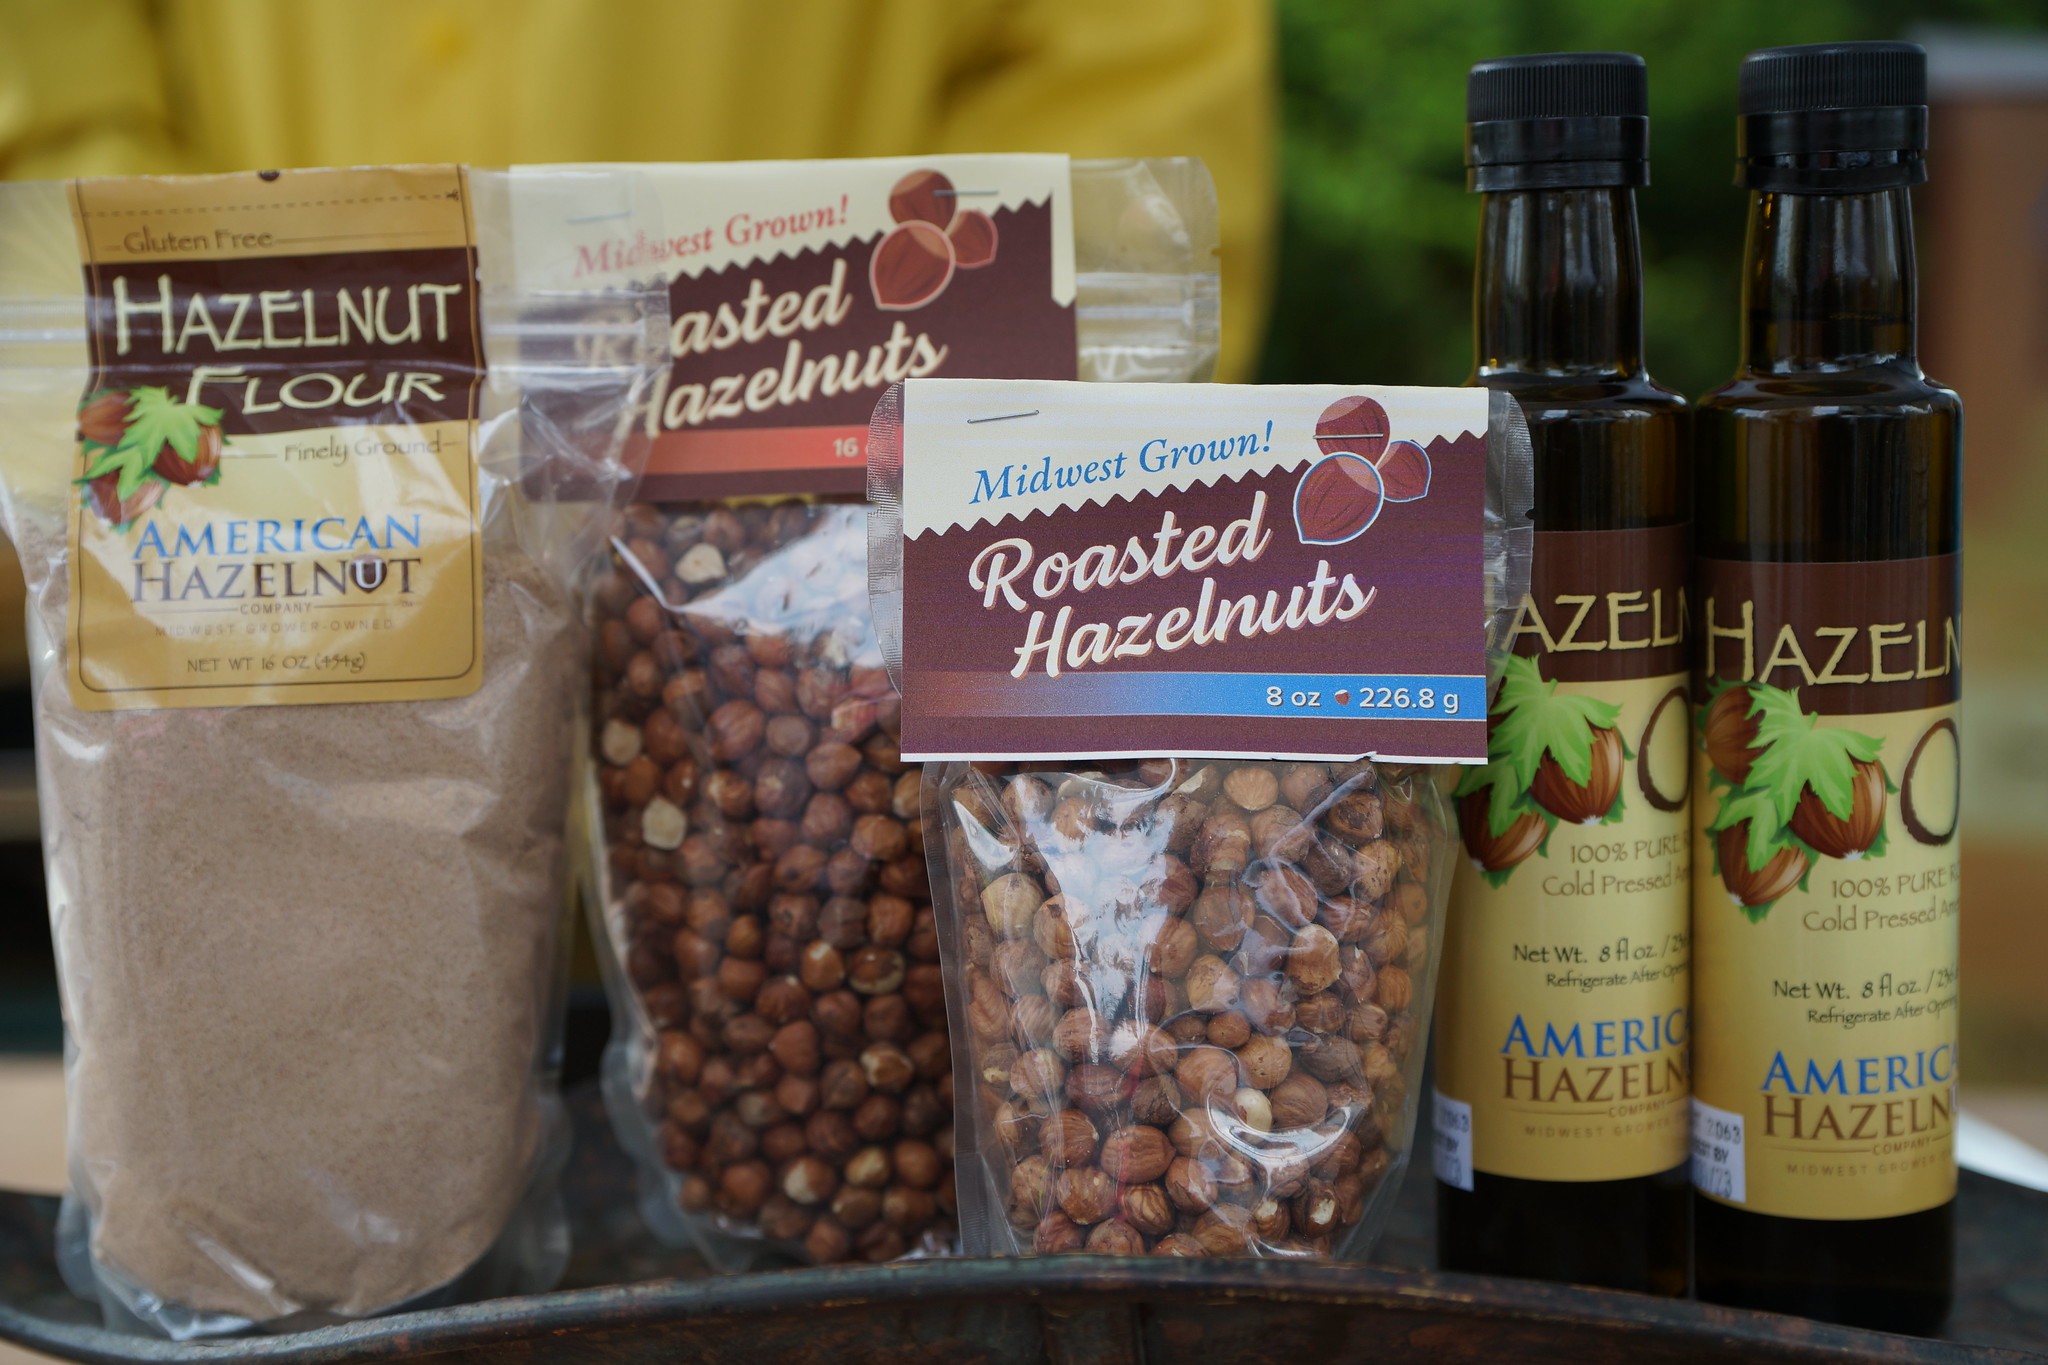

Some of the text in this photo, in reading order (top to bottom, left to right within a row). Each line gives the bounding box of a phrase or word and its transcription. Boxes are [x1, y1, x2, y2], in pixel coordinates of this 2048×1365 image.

[122, 224, 274, 255] Gluten Free
[574, 193, 849, 278] Midwest Grown!
[111, 272, 463, 355] HAZELNUT
[185, 365, 447, 415] FLOUR
[603, 320, 949, 458] Hazelnuts
[283, 430, 442, 467] Finely Ground
[832, 436, 860, 458] 16
[968, 419, 1275, 505] Midwest Grown!
[130, 513, 423, 560] AMERICAN
[968, 490, 1273, 612] Roasted
[131, 554, 422, 603] HAZELNUT
[239, 602, 312, 615] COMPANY
[1009, 558, 1378, 680] Hazelnuts
[154, 623, 235, 637] MIDWEST
[186, 651, 366, 674] NET WT 16 OZ (454g)
[1266, 685, 1460, 715] 8 oz 226.8 g
[1569, 842, 1629, 864] 100%
[1634, 833, 1681, 861] PURE
[1542, 869, 1595, 897] Cold
[1601, 860, 1673, 895] Pressed
[1831, 876, 1892, 899] 100%
[1897, 866, 1948, 895] PURE
[1803, 904, 1857, 932] Cold
[1864, 894, 1937, 931] Pressed
[1513, 944, 1549, 963] Net
[1554, 945, 1588, 964] Wt.
[1598, 946, 1611, 963] 8
[1615, 937, 1629, 962] fl
[1546, 969, 1628, 994] Refrigerate
[1630, 964, 1662, 985] After
[1773, 979, 1811, 999] Net
[1816, 982, 1850, 1000] Wt.
[1861, 981, 1874, 999] 8
[1879, 973, 1893, 998] fl
[1807, 1006, 1891, 1030] Refrigerate
[1893, 1000, 1926, 1020] After
[1501, 1008, 1690, 1059] AMERIC
[1501, 1051, 1691, 1103] HAZELN
[1607, 1100, 1666, 1118] COMPANY
[1524, 1125, 1605, 1139] MIDWEST
[1871, 1136, 1932, 1157] COMPANY
[1713, 1146, 1730, 1165] BY
[1786, 1163, 1868, 1178] MIDWEST
